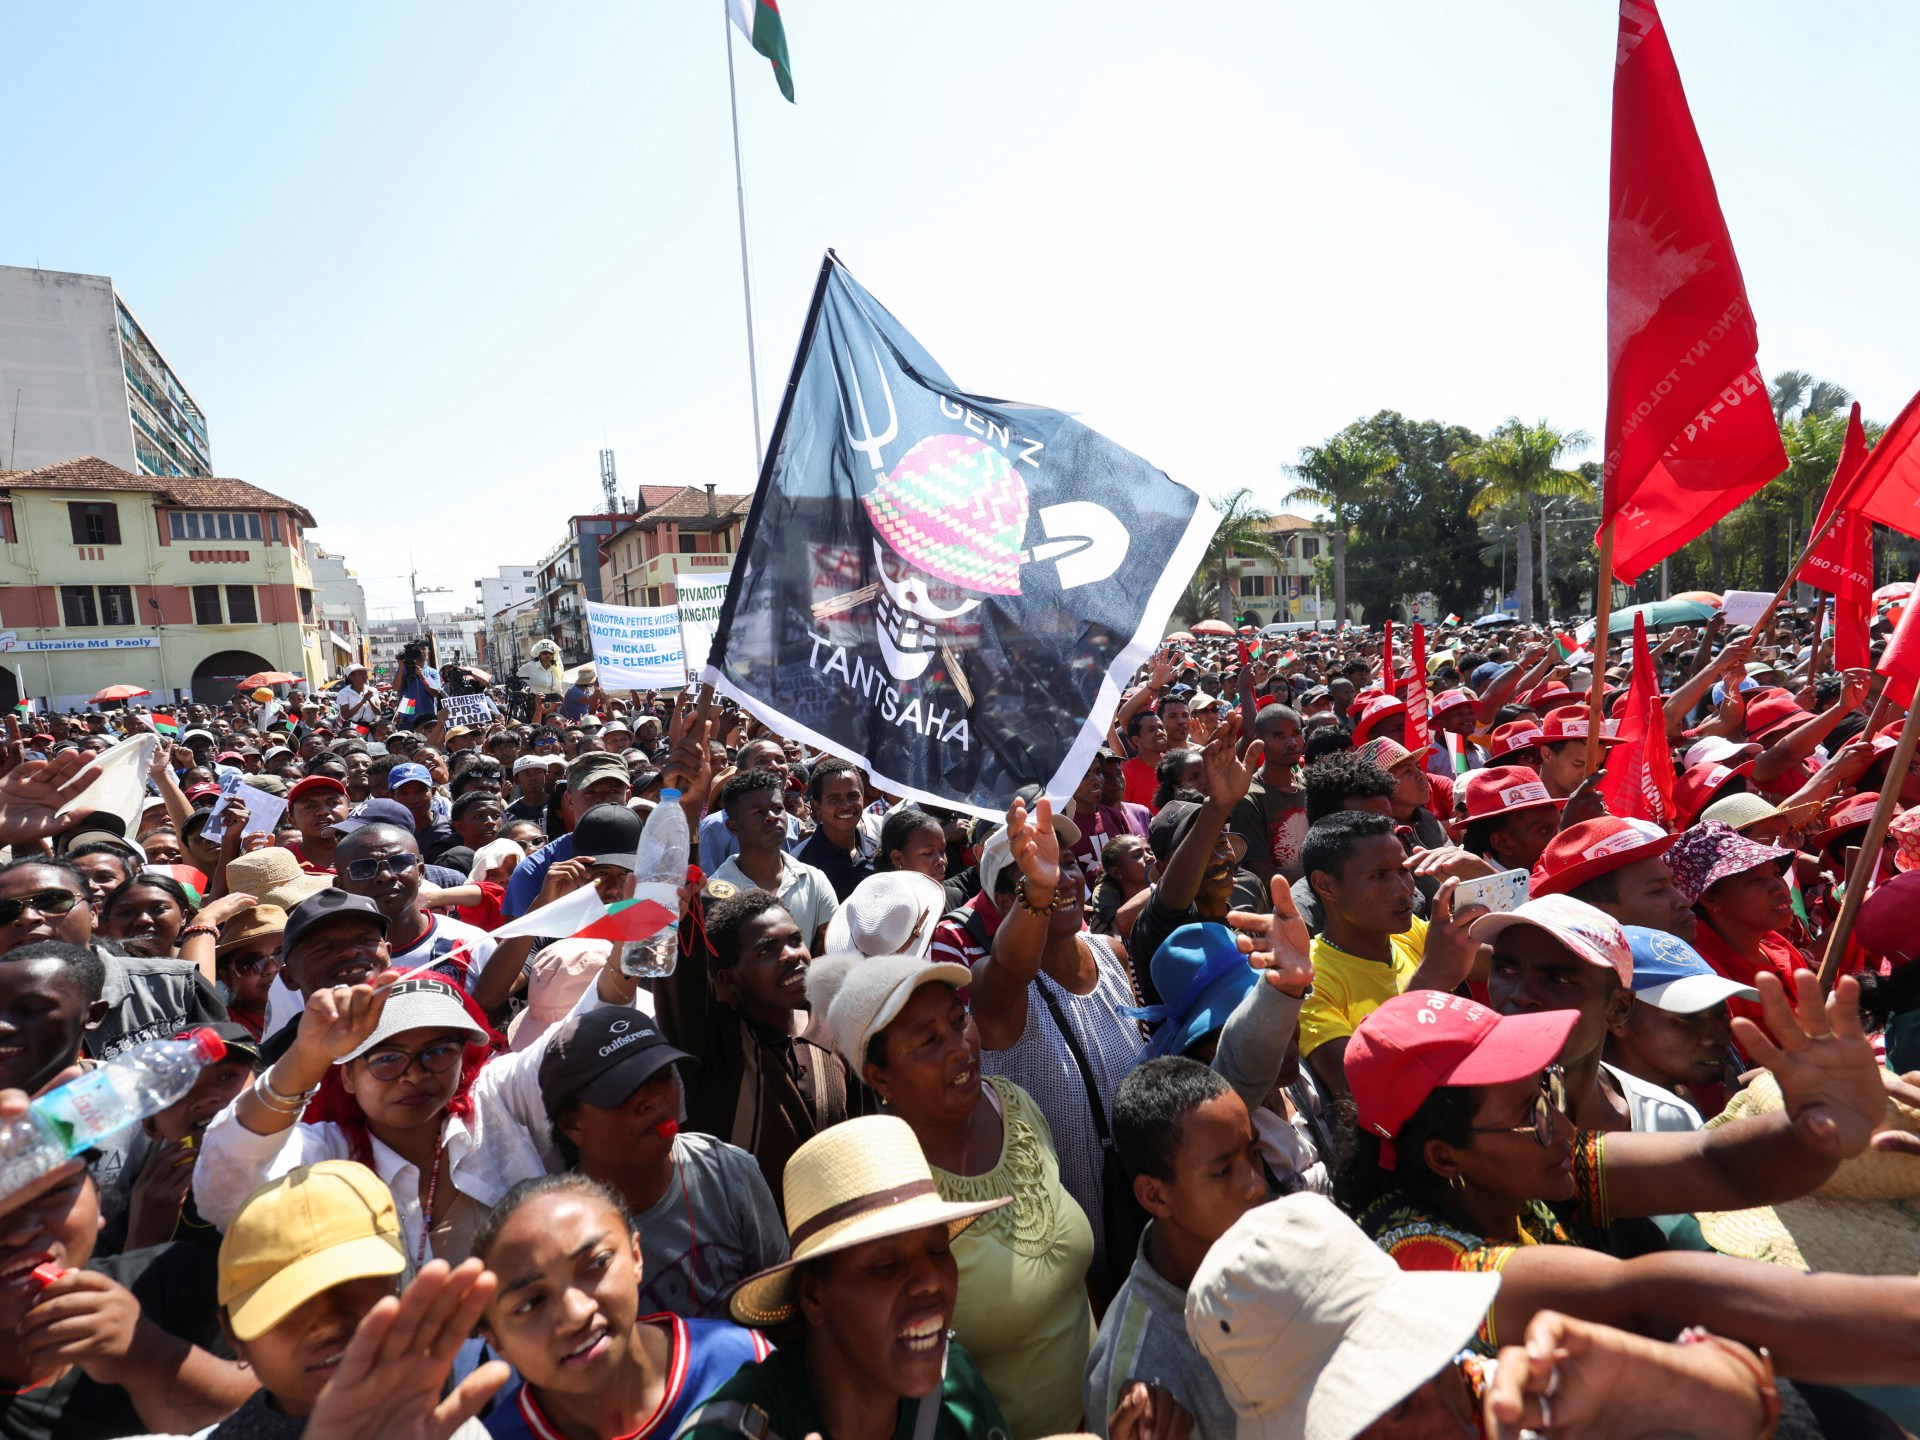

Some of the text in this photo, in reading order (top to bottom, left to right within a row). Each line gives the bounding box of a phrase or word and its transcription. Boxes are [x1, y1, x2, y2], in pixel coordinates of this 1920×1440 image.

[940, 395, 1009, 449] GEN
[627, 617, 653, 626] PETITE
[631, 625, 681, 639] PRESIDENT
[26, 638, 151, 650] Librairie Md Paoly
[612, 643, 657, 654] MICKAEL
[622, 650, 684, 667] CLEMENCE
[807, 630, 969, 752] TANTSAHA
[442, 695, 485, 709] CLEMENCE
[451, 704, 481, 716] PDS
[448, 713, 490, 726] TANA
[599, 1028, 655, 1057] Gulfstream
